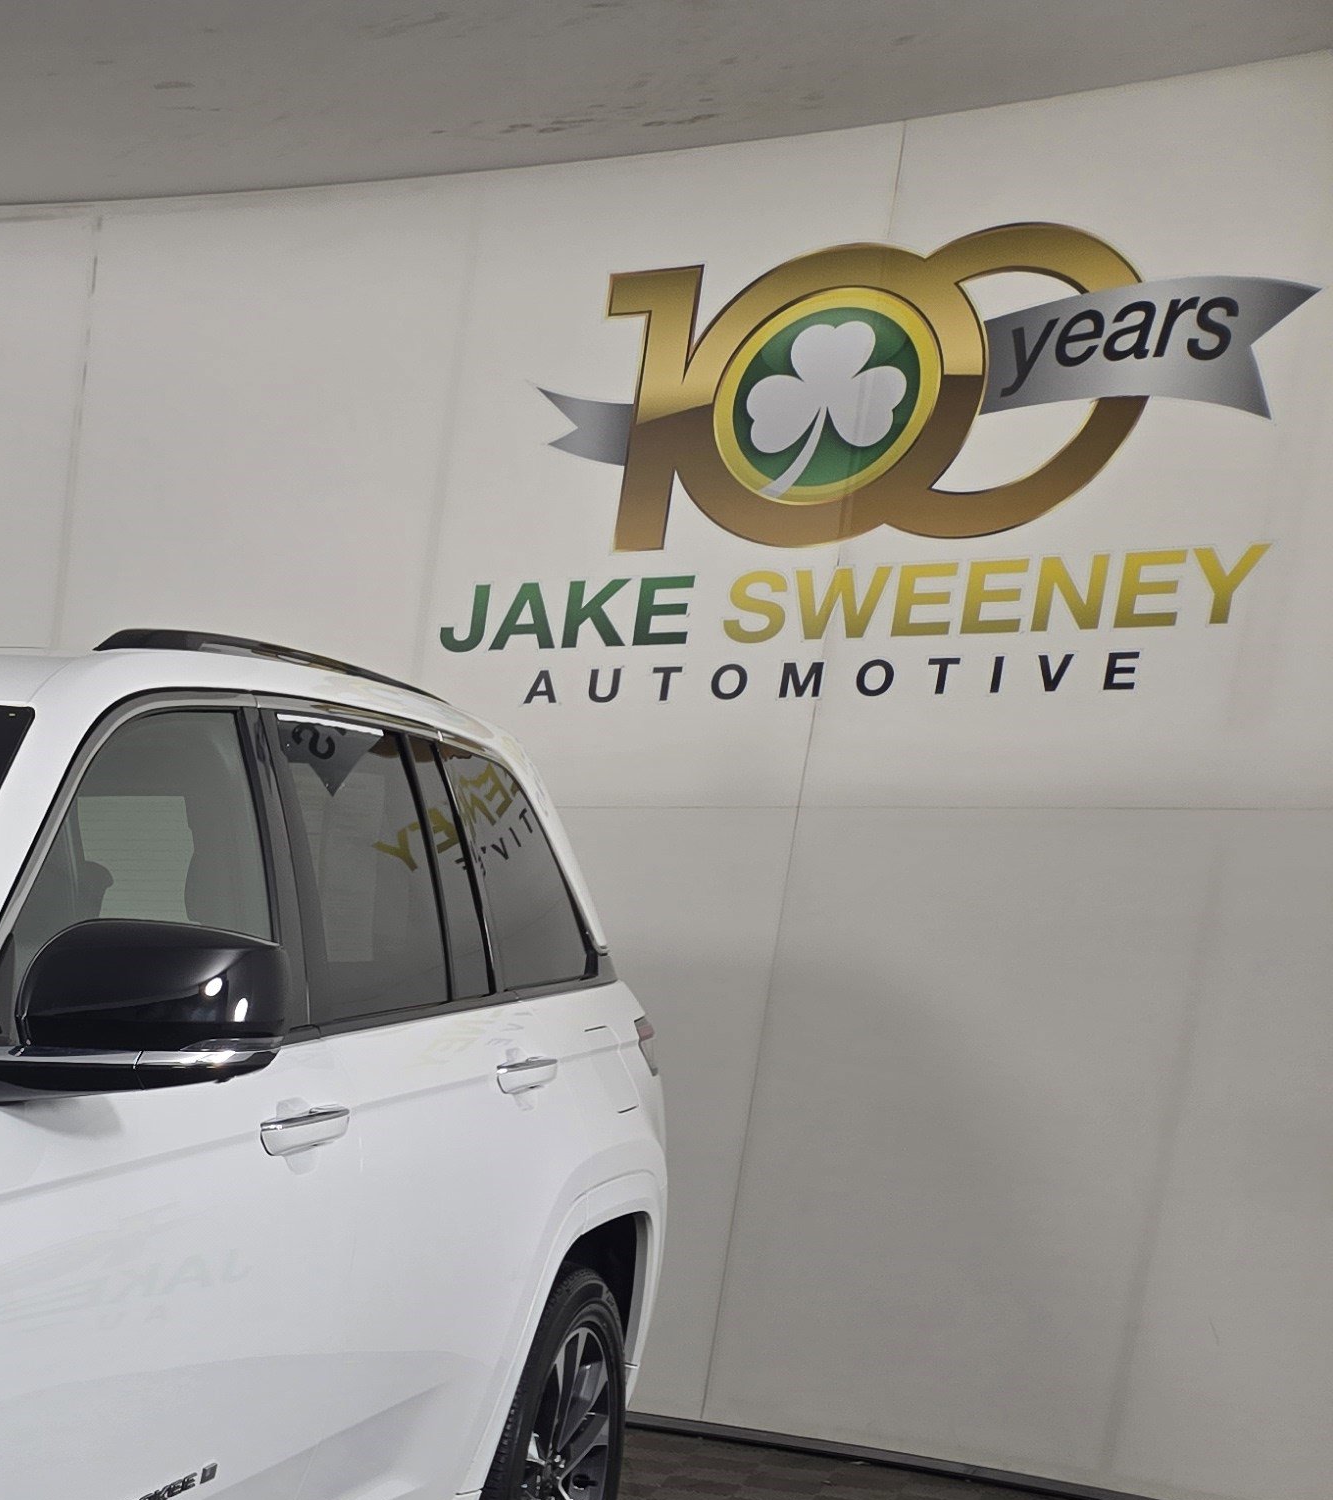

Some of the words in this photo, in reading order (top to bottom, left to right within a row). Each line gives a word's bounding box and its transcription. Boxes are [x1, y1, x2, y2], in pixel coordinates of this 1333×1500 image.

[606, 221, 1149, 553] 100
[1000, 293, 1240, 398] years
[439, 574, 696, 654] JAKE
[722, 542, 1272, 645] SWEENEY
[523, 650, 1142, 706] AUTOMOTIVE
